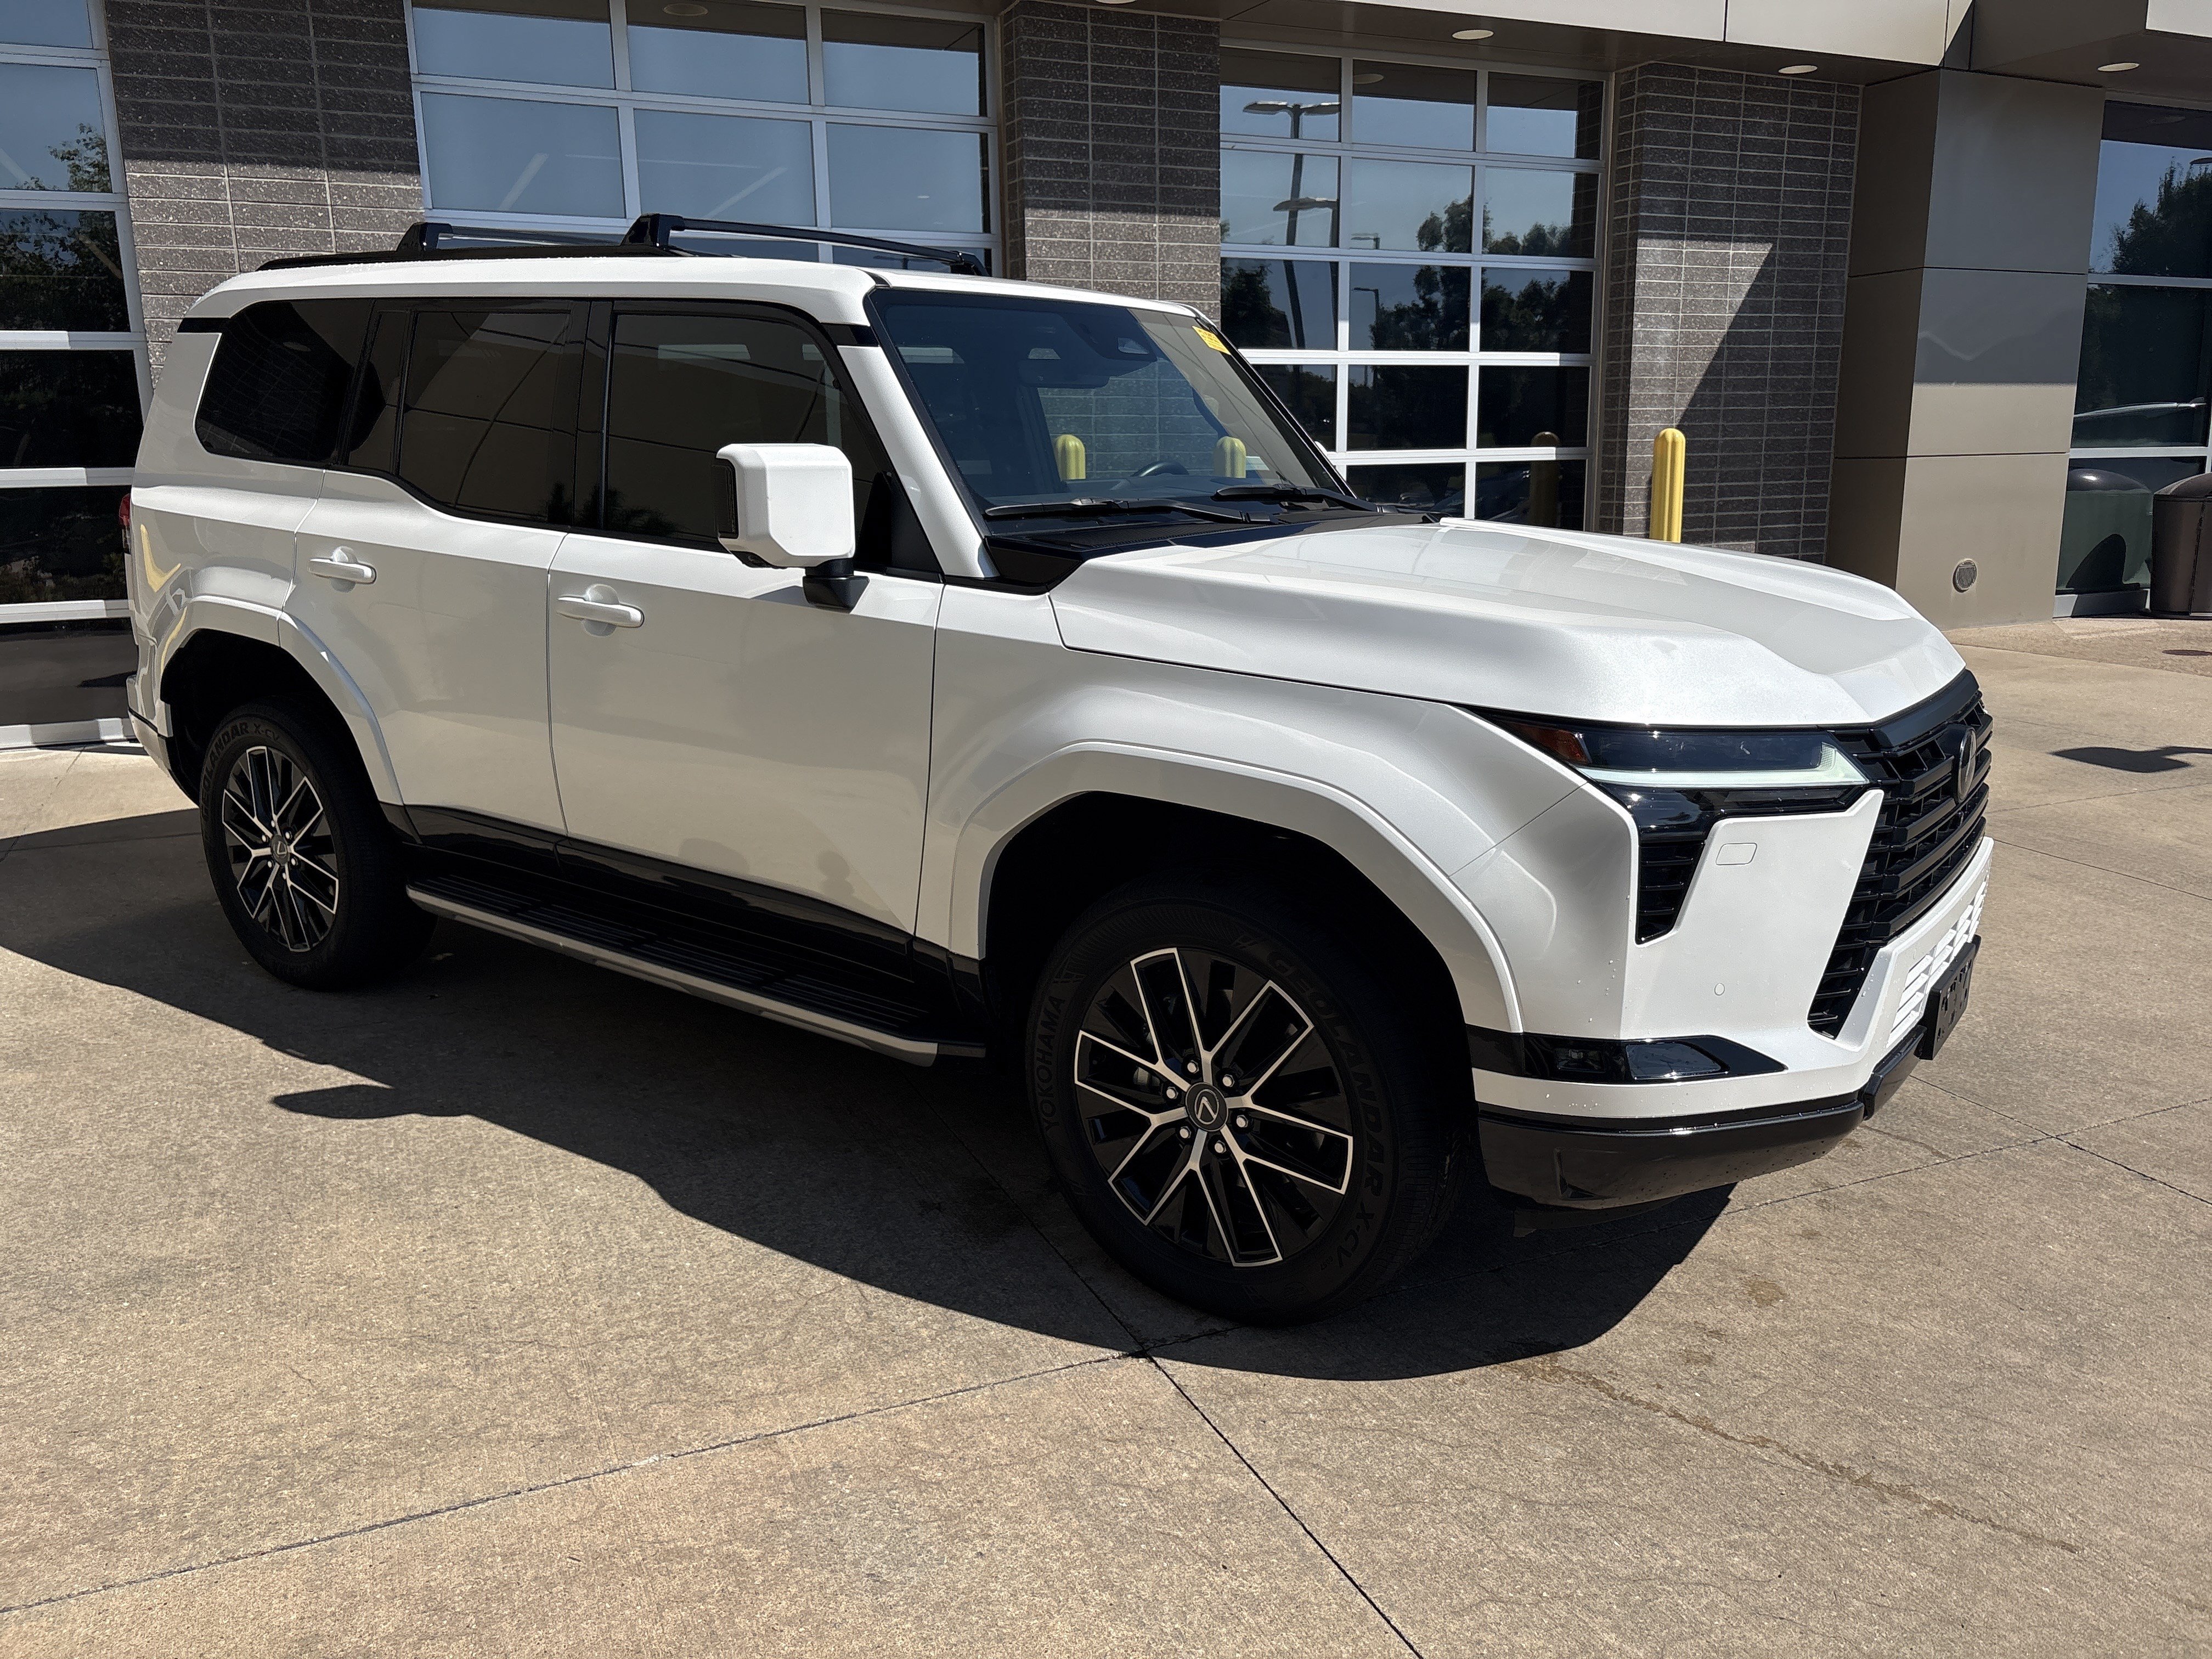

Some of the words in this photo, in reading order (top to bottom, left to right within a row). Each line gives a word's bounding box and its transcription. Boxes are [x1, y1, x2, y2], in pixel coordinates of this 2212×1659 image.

[253, 723, 280, 742] X-CV
[1036, 996, 1065, 1131] YOKOHAMA
[1267, 951, 1384, 1197] GEOLANDAR
[1337, 1201, 1375, 1268] X-CV
